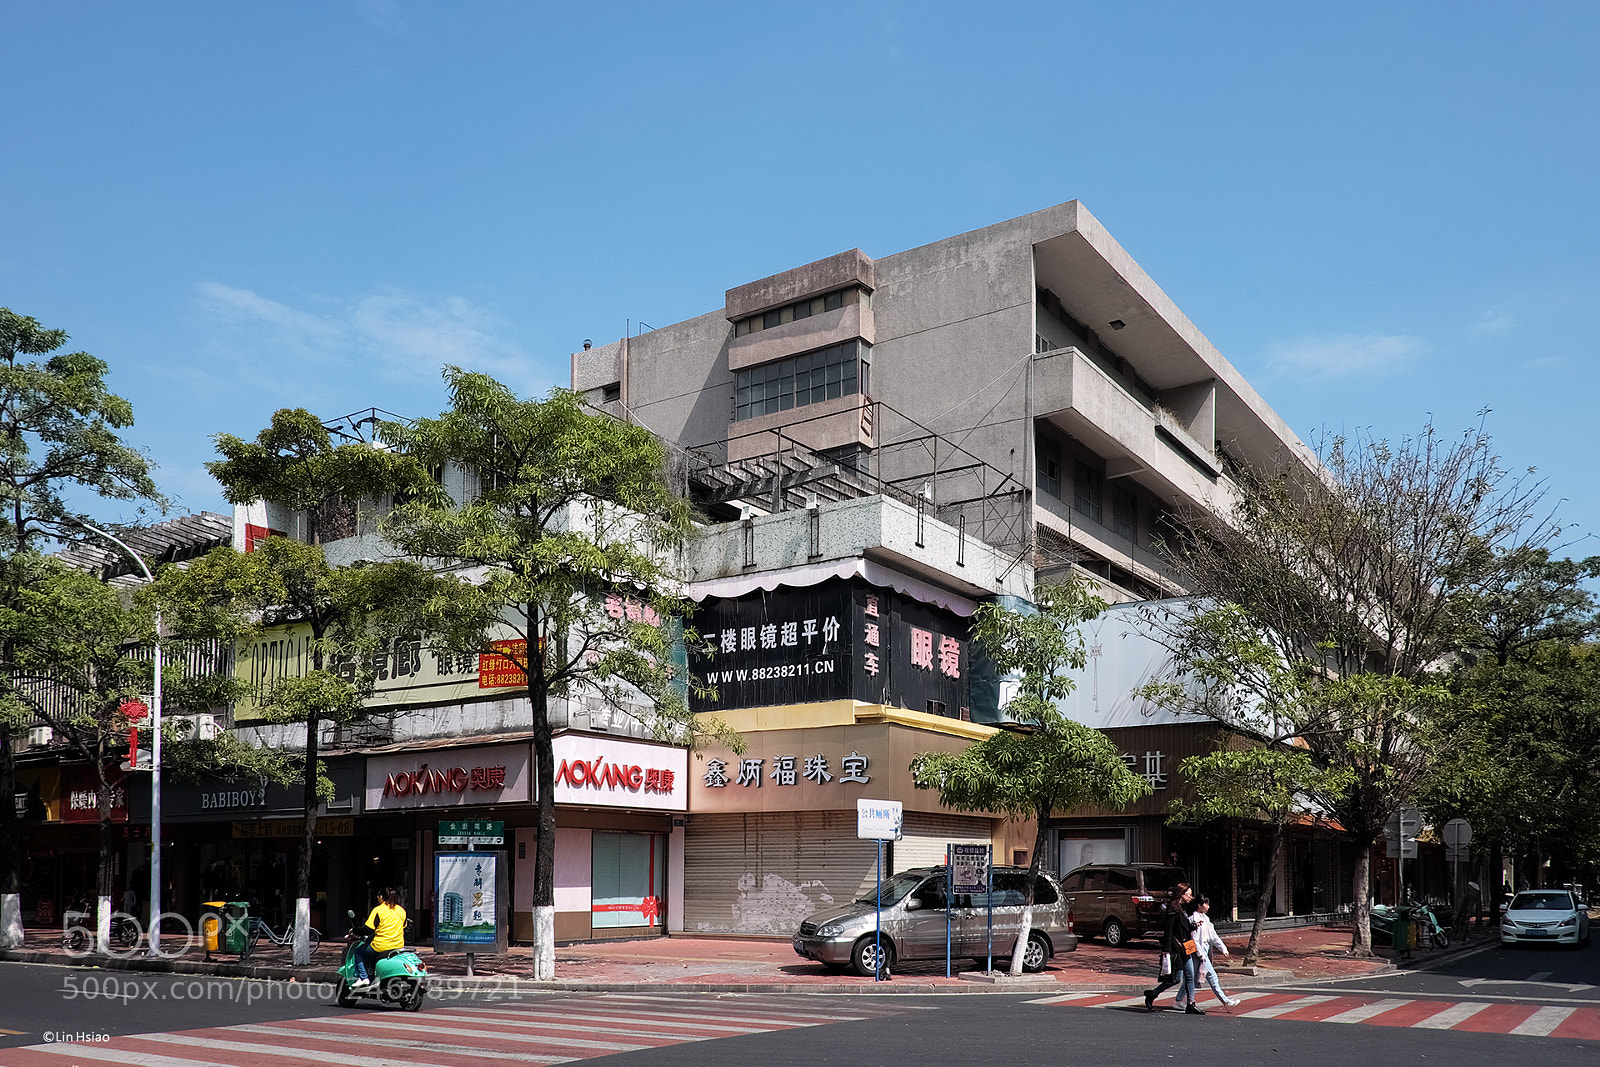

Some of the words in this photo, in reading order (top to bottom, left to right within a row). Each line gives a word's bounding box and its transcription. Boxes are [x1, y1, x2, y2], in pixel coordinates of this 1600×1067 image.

[864, 594, 880, 676] 直通车
[911, 627, 961, 679] 眼镜
[383, 763, 469, 797] AOKANG
[470, 765, 506, 791] 奥康
[555, 756, 643, 791] AOKANG
[644, 768, 675, 794] 奥康
[702, 751, 872, 788] 鑫炳福珠宝
[202, 790, 257, 809] BABIBOY
[861, 807, 890, 820] 公共厕所
